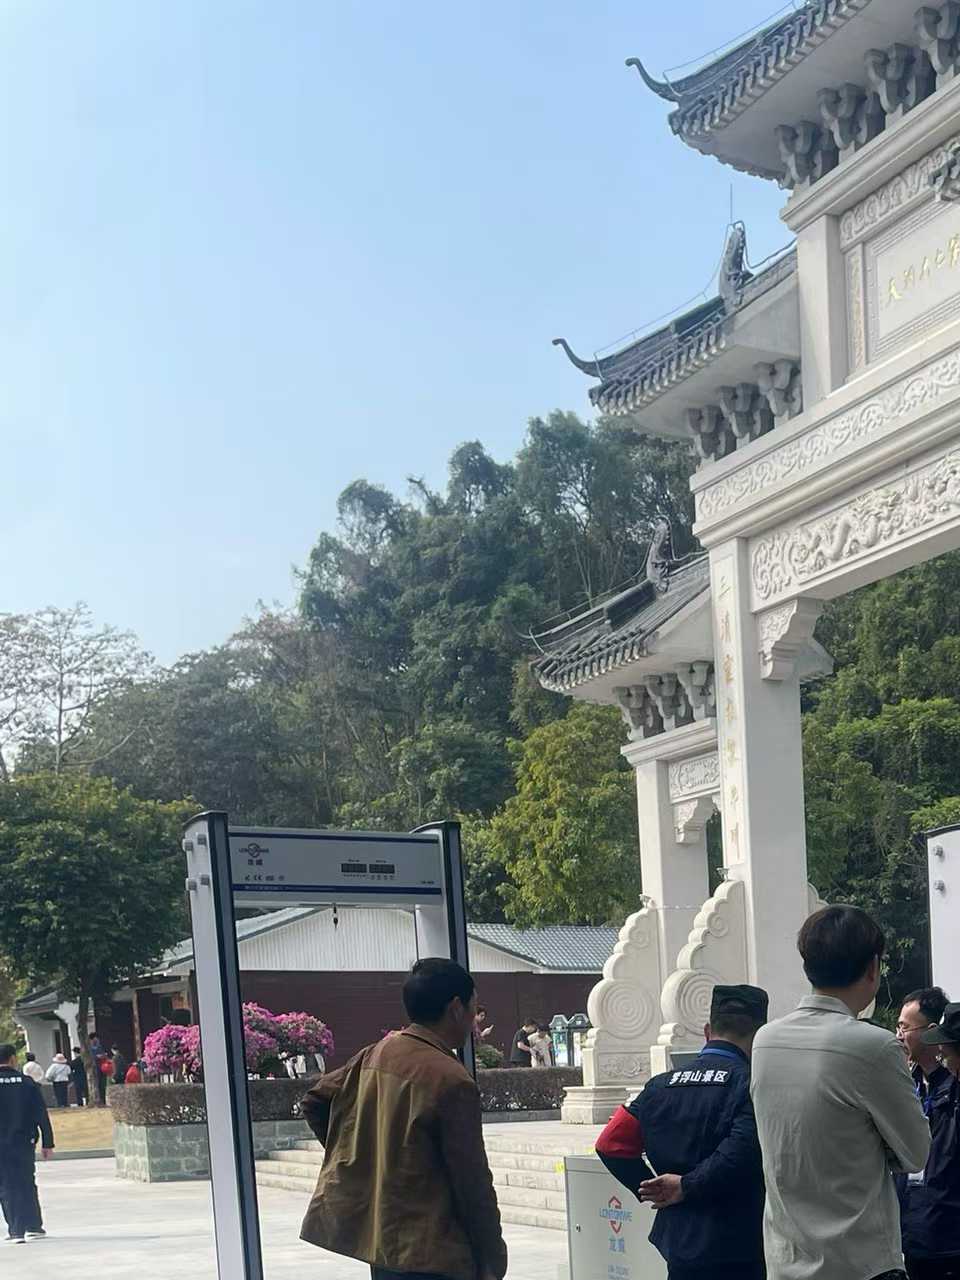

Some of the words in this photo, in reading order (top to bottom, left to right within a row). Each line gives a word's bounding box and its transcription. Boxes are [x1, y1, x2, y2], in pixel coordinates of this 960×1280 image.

[669, 1070, 728, 1085] 罗浮山景区
